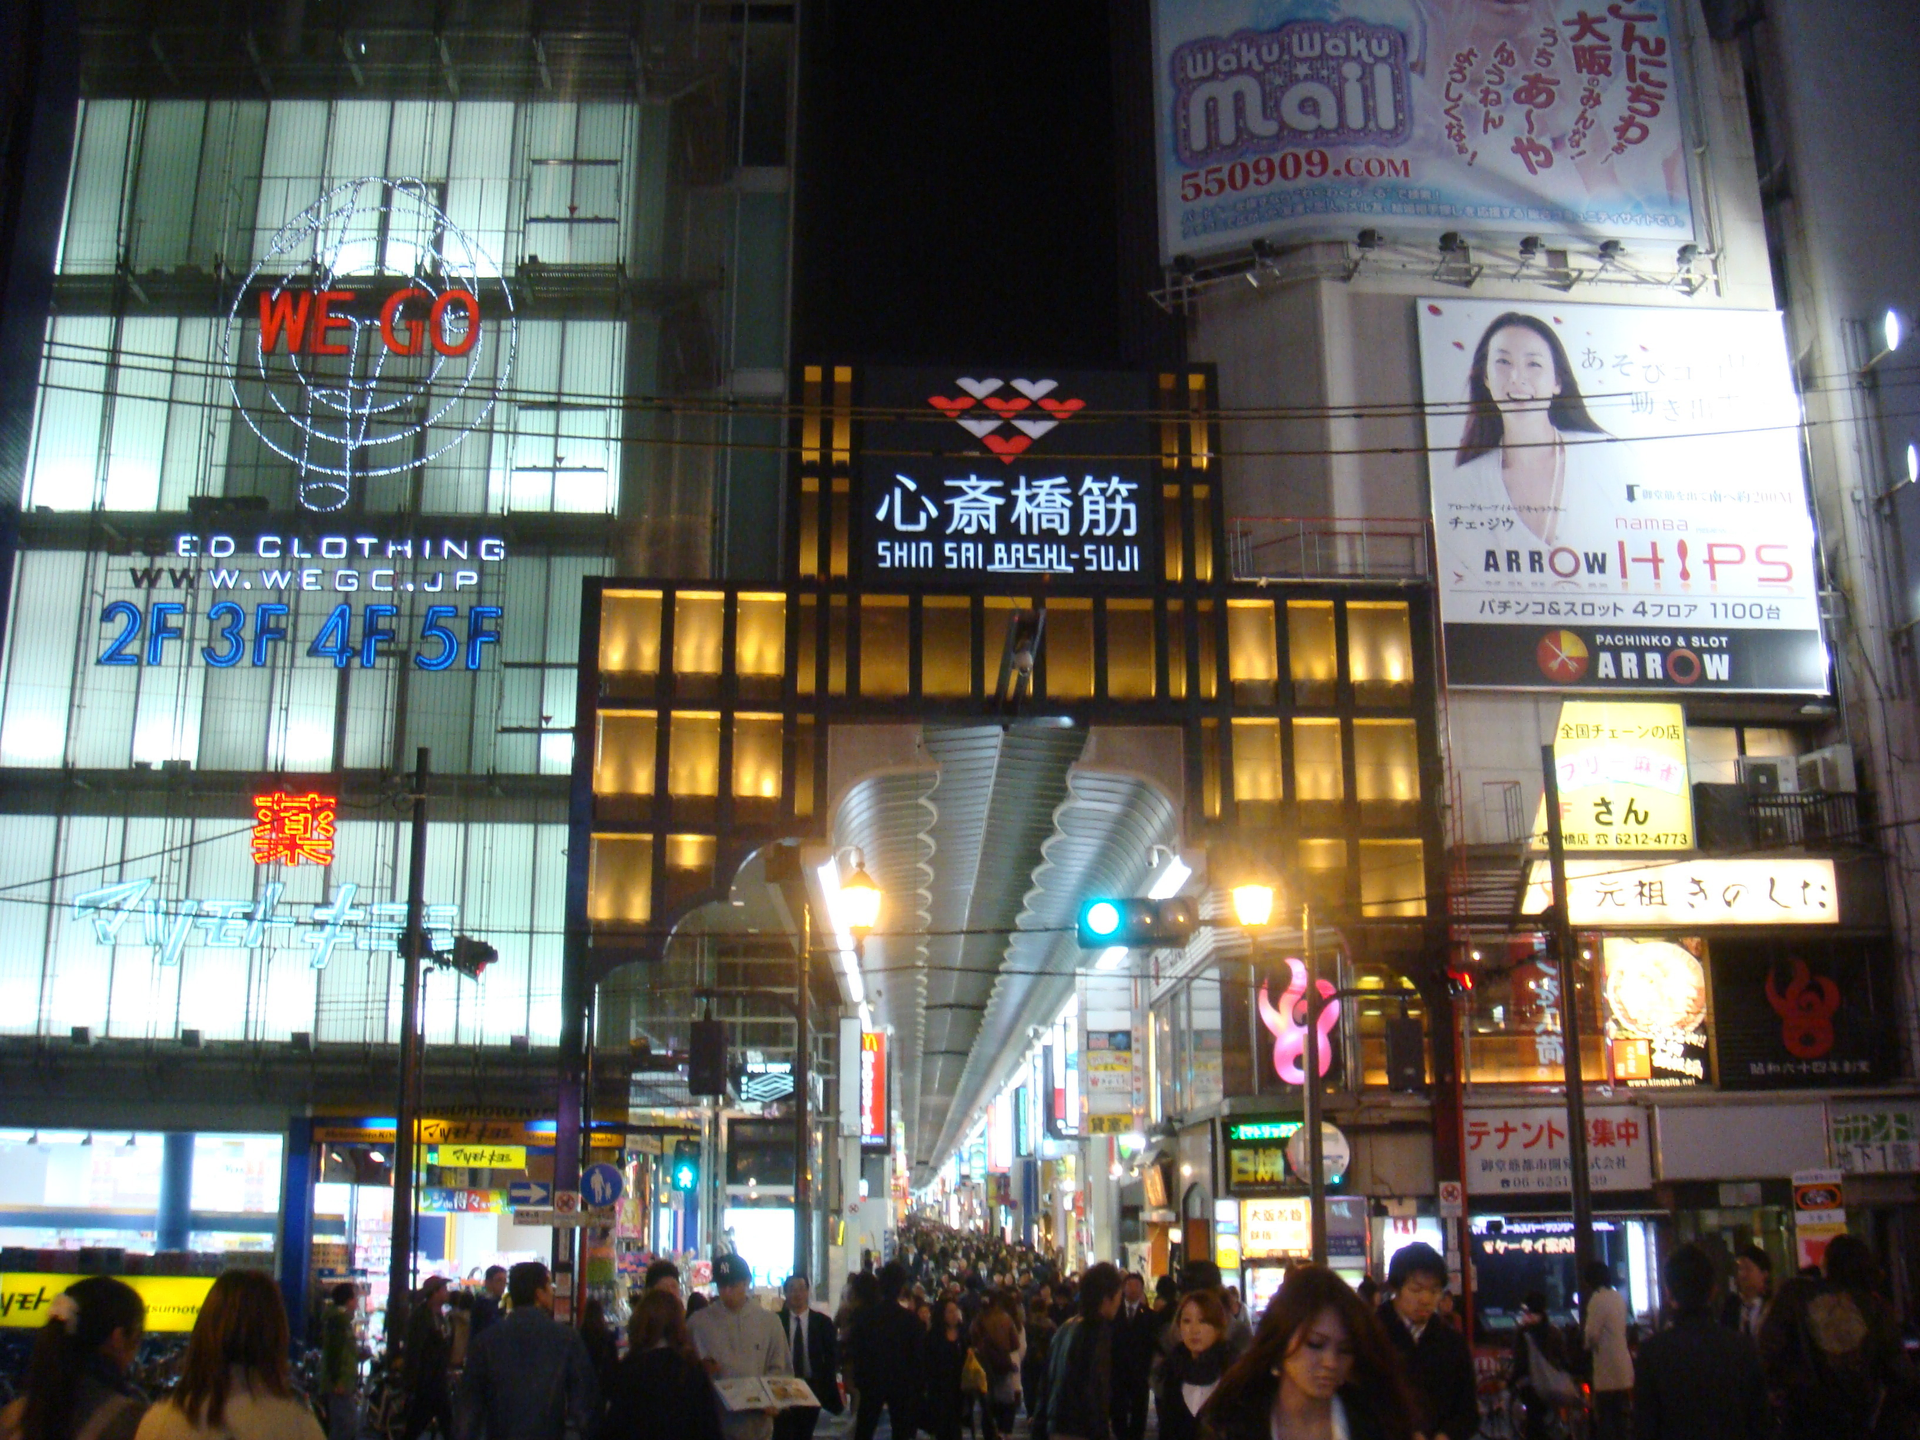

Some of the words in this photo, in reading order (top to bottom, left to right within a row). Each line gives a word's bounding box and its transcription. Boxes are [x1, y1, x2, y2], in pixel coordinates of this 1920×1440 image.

[875, 473, 1139, 537] 心斎橋筋
[1448, 516, 1515, 531] チェ・ジウ
[258, 535, 505, 562] CLOTHING
[877, 541, 933, 569] SHIN
[944, 542, 983, 570] SAI
[1484, 547, 1608, 578] ARROW
[1478, 599, 1625, 619] パチンコ&スロット
[1632, 600, 1699, 620] 4フロア
[1709, 601, 1782, 621] 1100台
[96, 600, 184, 667] 2F
[201, 602, 290, 668] 3F
[306, 603, 399, 669] 4F
[414, 604, 503, 671] 5F
[1595, 634, 1672, 648] PACHINKO
[1676, 636, 1687, 648] &
[1690, 636, 1729, 649] SLOT
[1597, 648, 1730, 685] ARROW
[1560, 723, 1681, 740] 全国チェーンの店
[1560, 755, 1678, 783] フリー麻雀
[1615, 833, 1688, 846] 6212-4773
[1467, 1116, 1639, 1151] テナント集中
